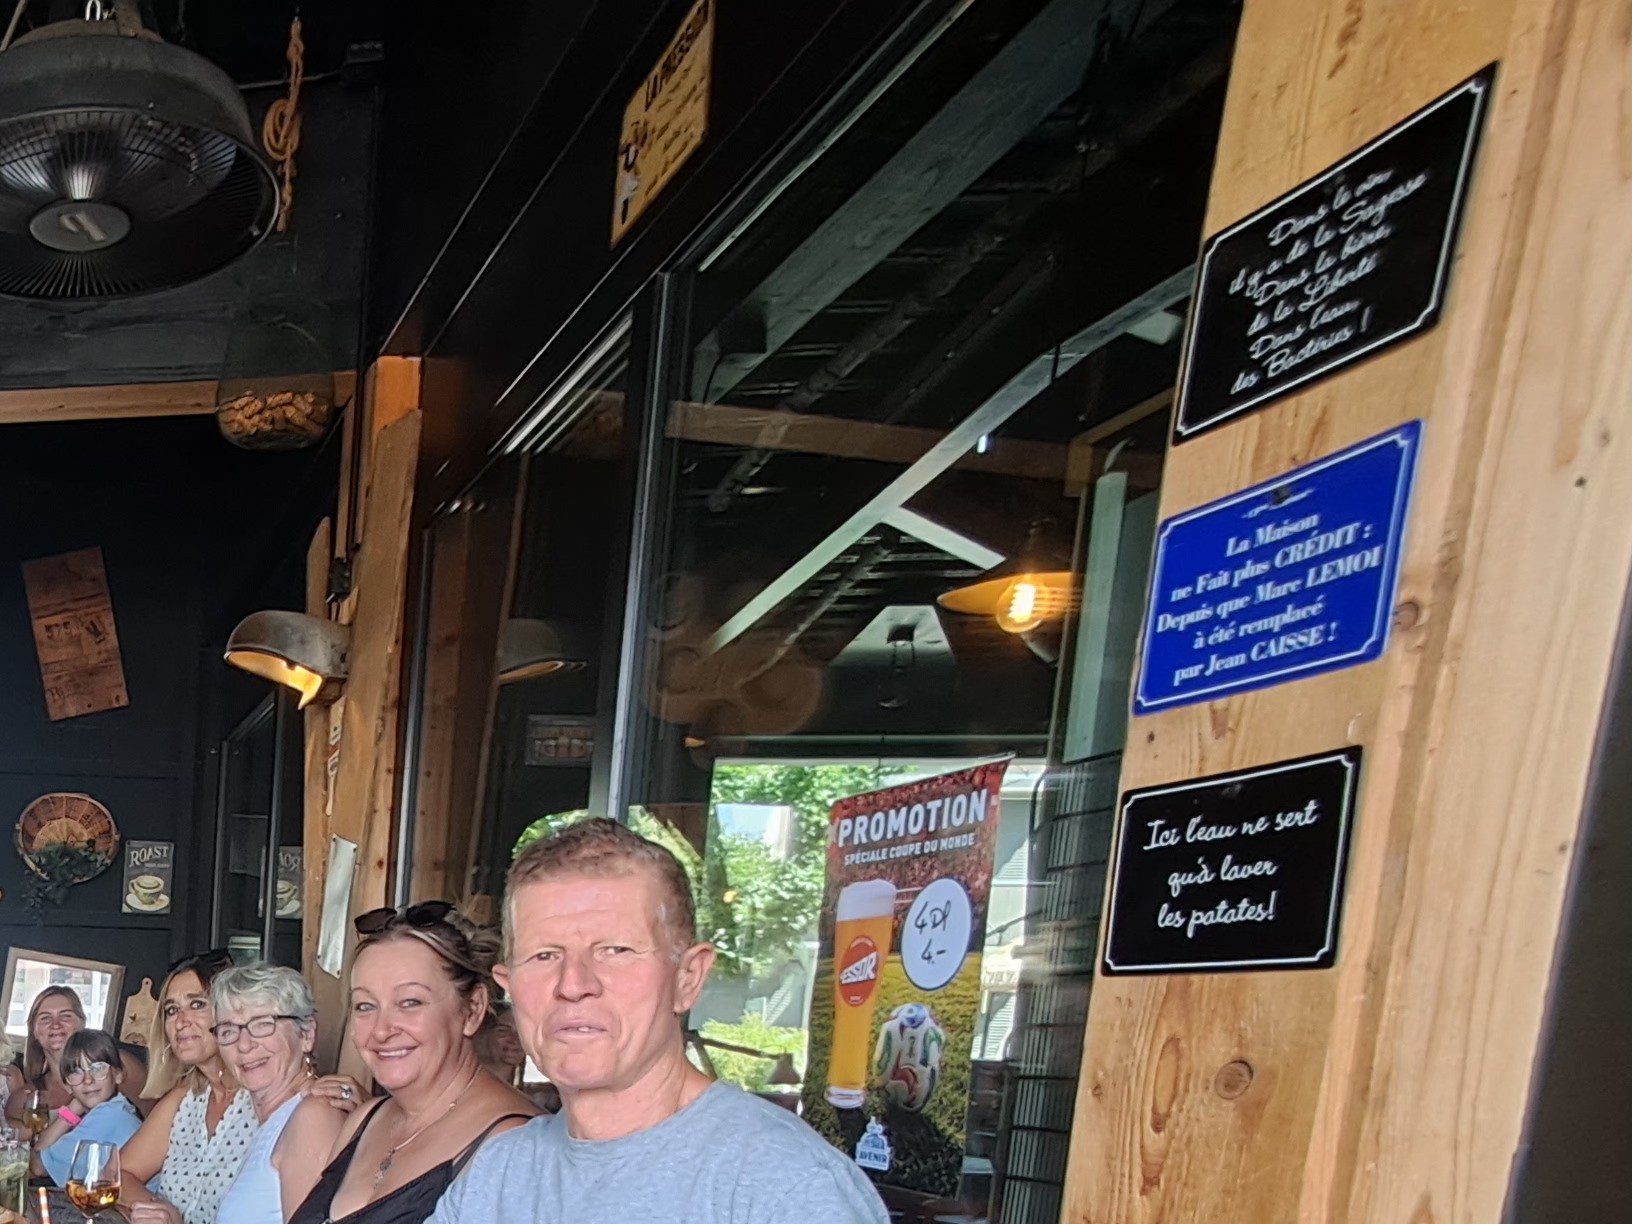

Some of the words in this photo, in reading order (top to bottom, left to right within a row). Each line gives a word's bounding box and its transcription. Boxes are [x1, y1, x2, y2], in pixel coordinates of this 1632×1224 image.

[1268, 203, 1330, 246] Dans
[1333, 184, 1352, 210] le
[1245, 270, 1265, 297] y
[1266, 258, 1284, 275] a
[1286, 238, 1310, 264] de
[1313, 223, 1337, 248] la
[1253, 268, 1311, 306] Dans
[1315, 251, 1337, 274] la
[1247, 312, 1269, 336] de
[1274, 300, 1294, 322] la
[1298, 252, 1378, 312] Liberté
[1249, 323, 1306, 359] Dans
[1230, 370, 1261, 395] des
[1170, 583, 1193, 602] ne
[1195, 569, 1230, 596] Fait
[1232, 559, 1270, 588] plus
[1274, 521, 1362, 569] CRÉDIT
[1225, 536, 1250, 557] La
[1253, 513, 1320, 549] Maison
[1156, 603, 1214, 634] Depuis
[1216, 594, 1251, 620] que
[1252, 579, 1301, 603] Marc
[1193, 632, 1205, 650] à
[1207, 621, 1236, 646] été
[1238, 593, 1327, 639] remplacé
[1172, 663, 1205, 687] par
[1204, 651, 1247, 677] Jean
[1250, 627, 1324, 663] CAISSE
[838, 788, 988, 848] PROMOTION
[1143, 818, 1182, 851] Ici
[1186, 814, 1239, 843] l'eau
[1241, 814, 1271, 836] ne
[1274, 799, 1321, 831] sert
[129, 846, 170, 868] ROAST
[843, 848, 888, 867] SPÉCIALE
[889, 842, 923, 860] COUPE
[923, 839, 939, 853] DU
[939, 832, 976, 852] MONDE
[1220, 854, 1281, 882] laver
[1157, 902, 1186, 928] les
